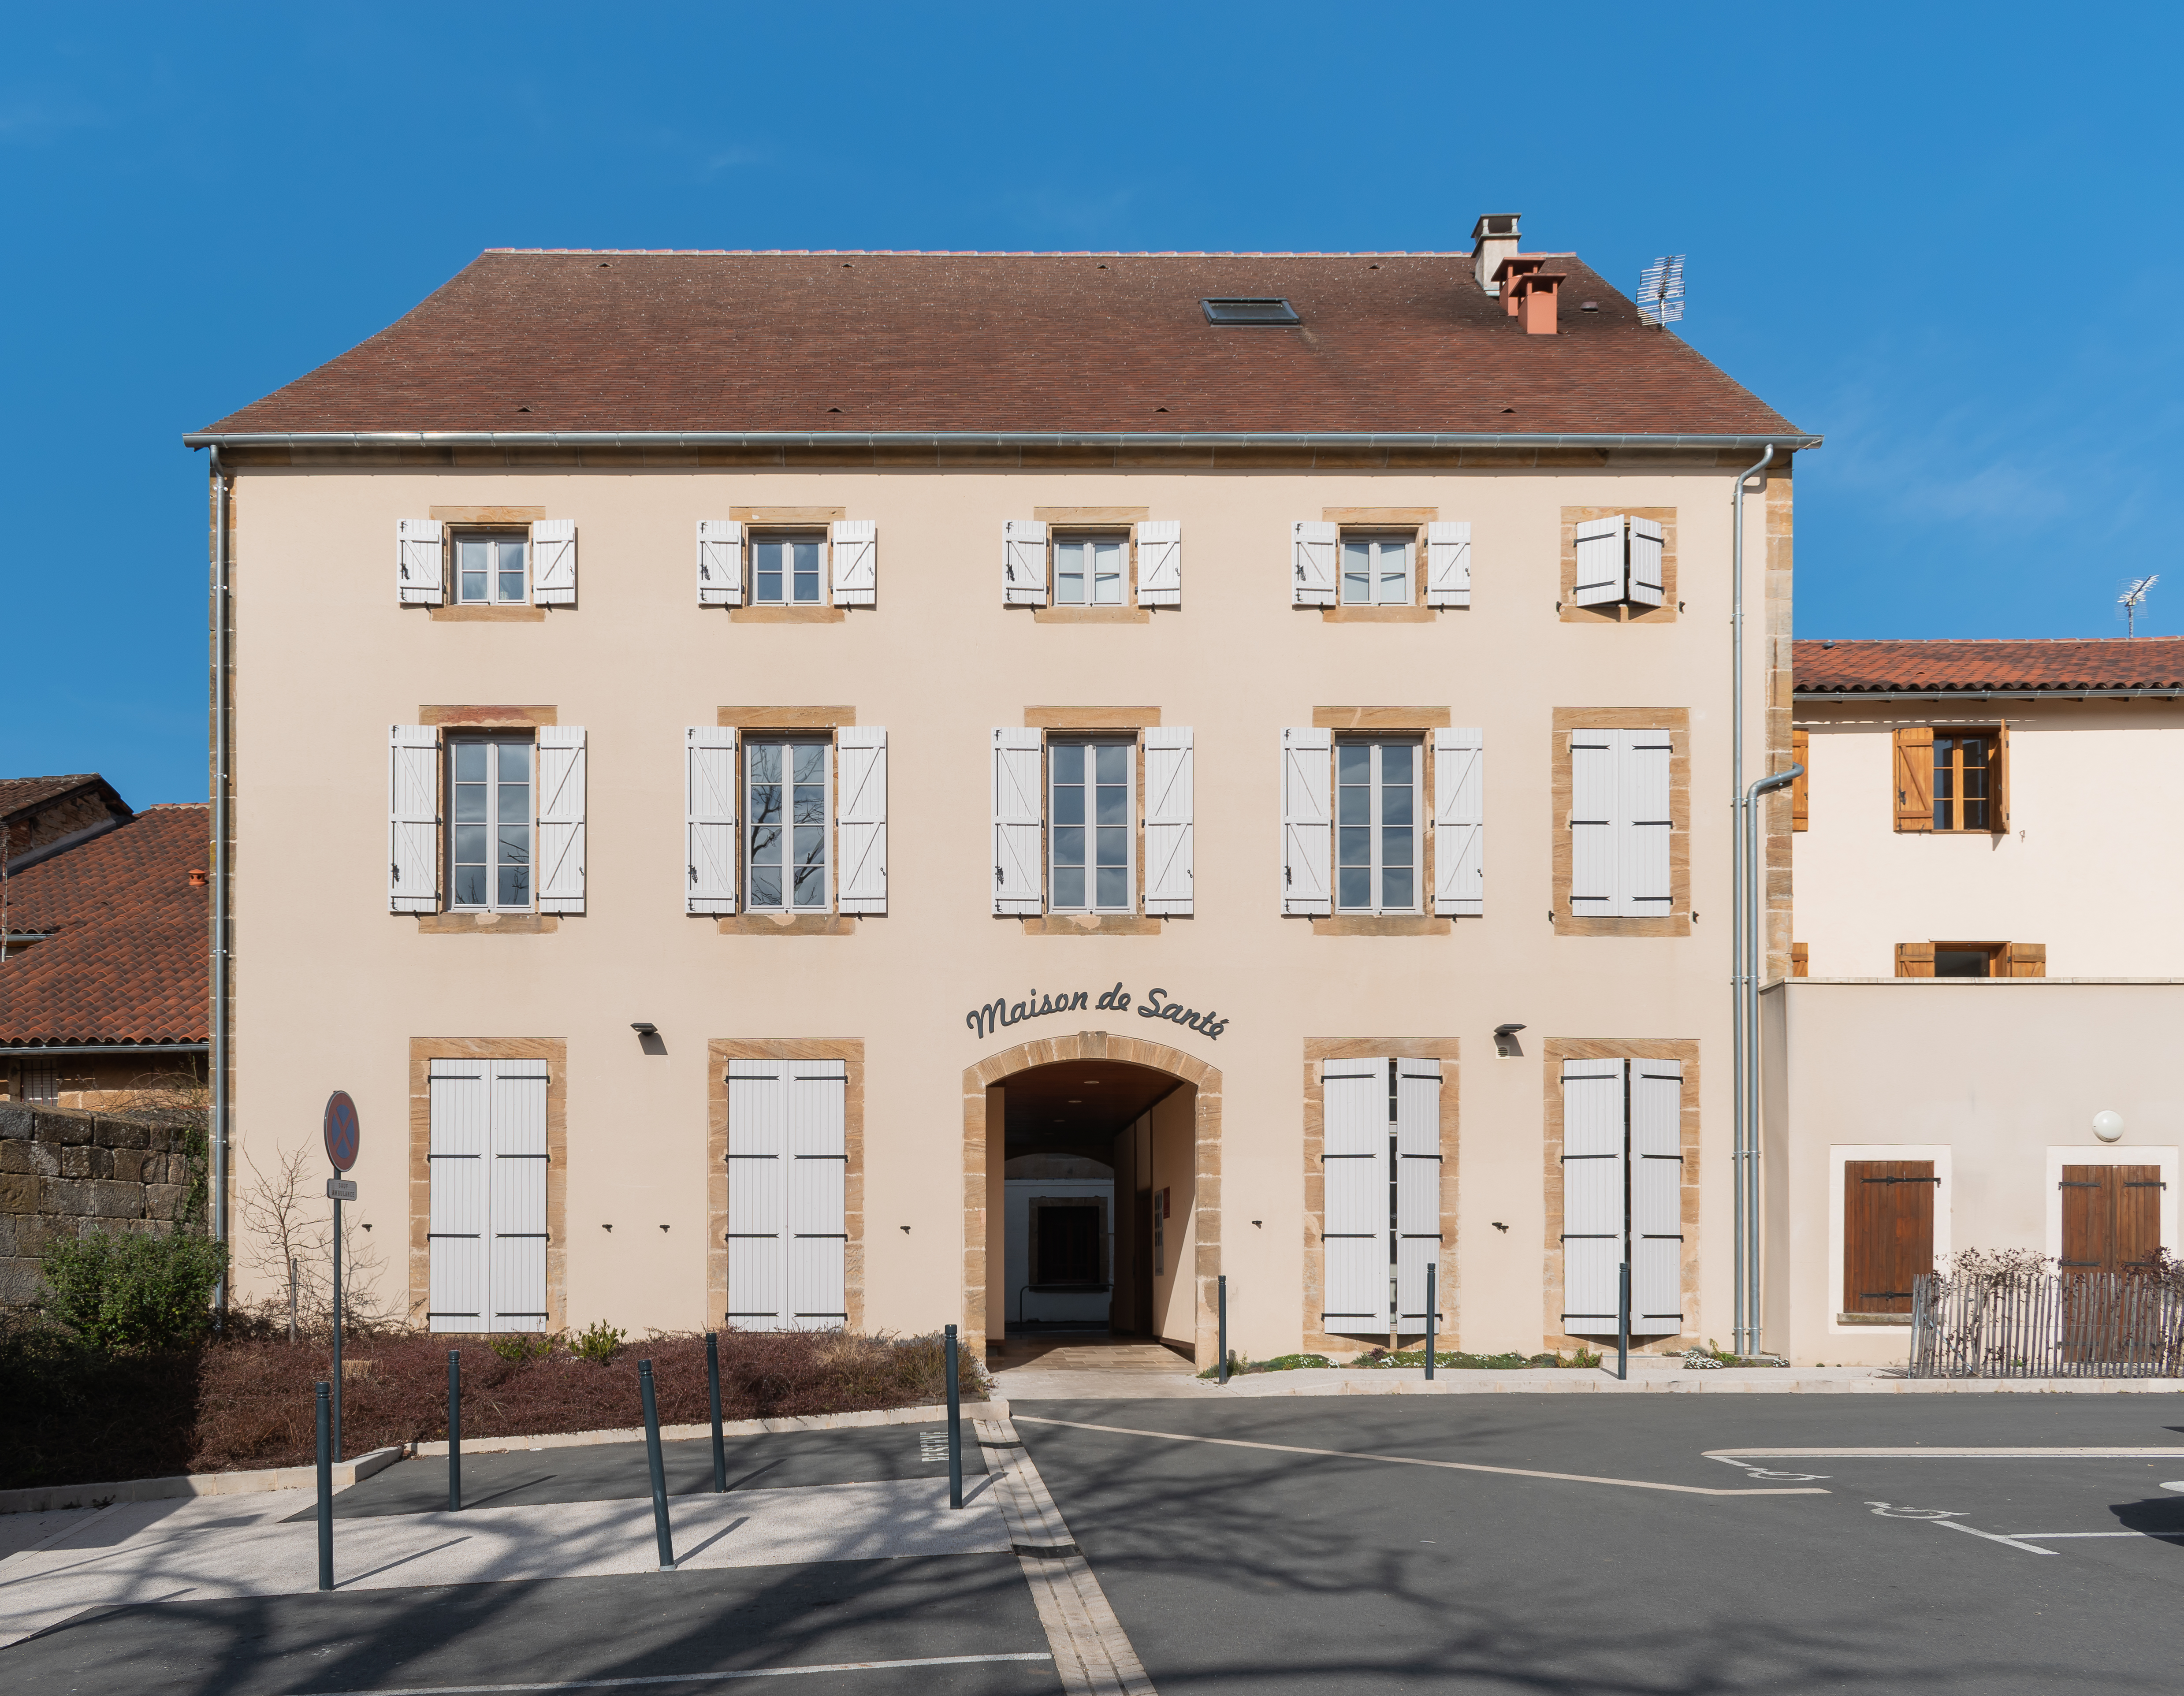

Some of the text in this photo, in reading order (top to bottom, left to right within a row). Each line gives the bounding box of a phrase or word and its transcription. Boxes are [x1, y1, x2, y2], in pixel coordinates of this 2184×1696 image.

[966, 982, 1230, 1041] Maison de Santé
